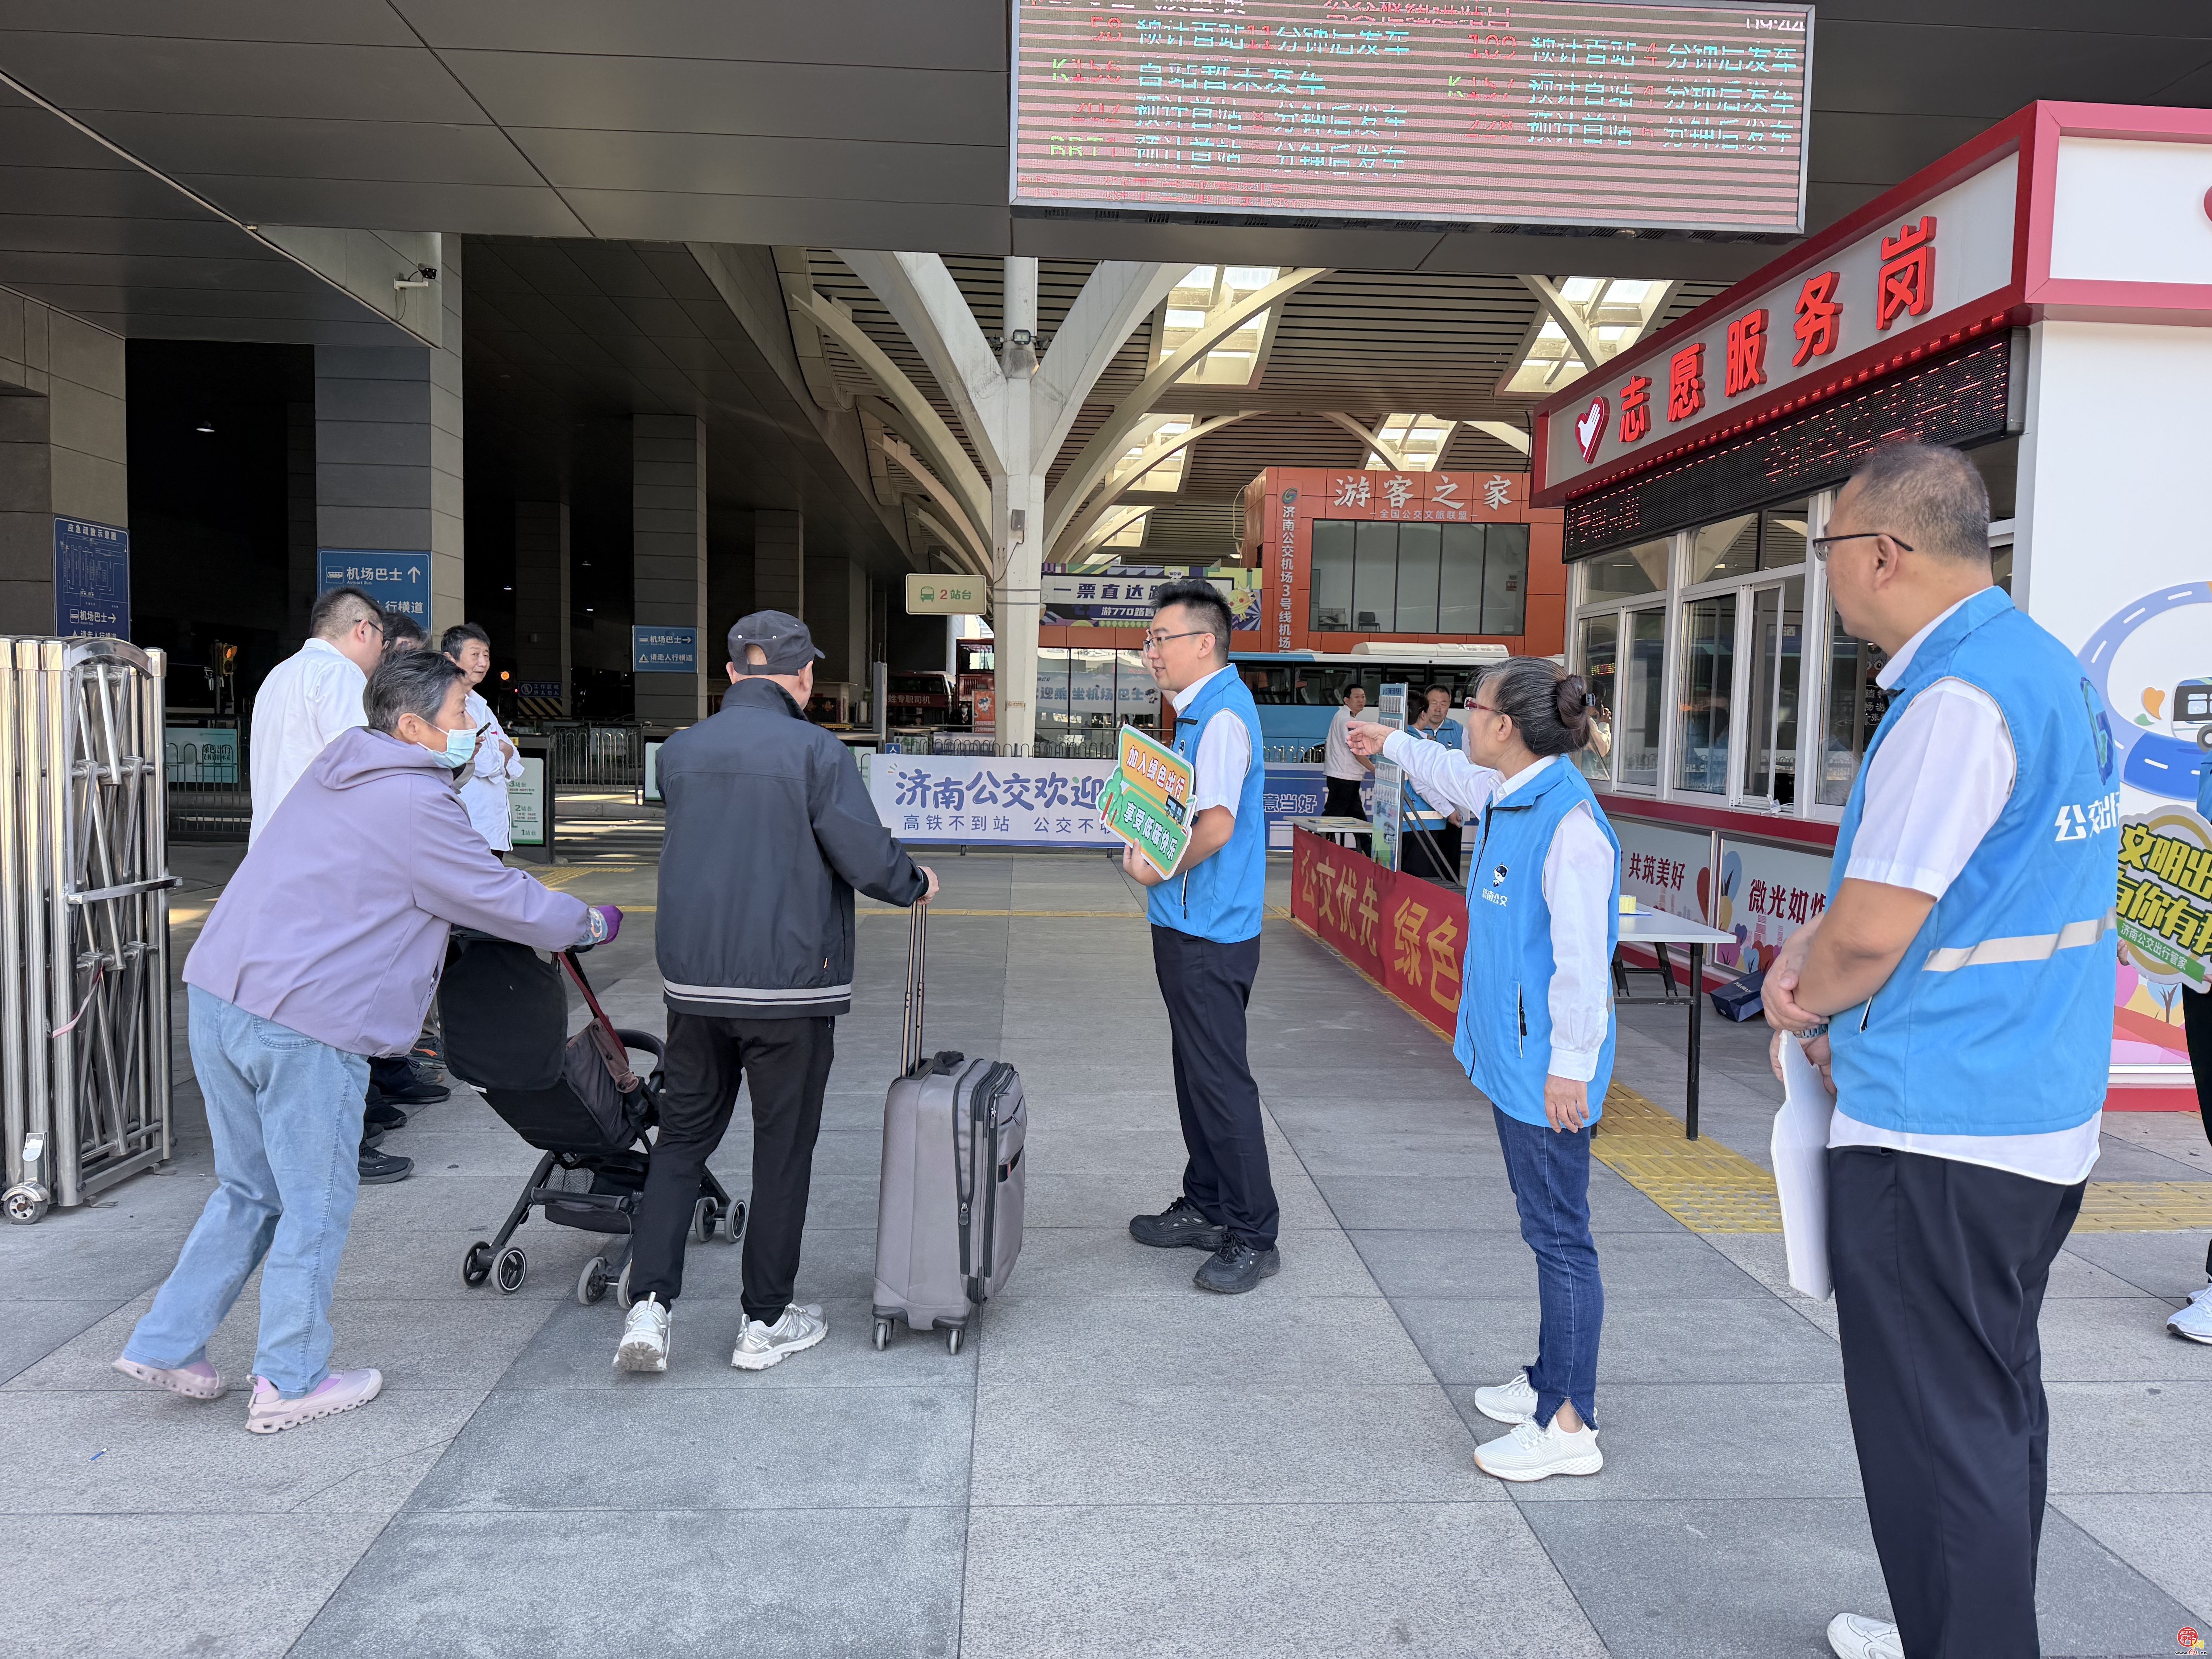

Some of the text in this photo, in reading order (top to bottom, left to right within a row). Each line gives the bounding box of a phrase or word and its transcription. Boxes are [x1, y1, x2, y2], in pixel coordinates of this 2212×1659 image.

[1619, 215, 1937, 443] 志愿服务岗
[1333, 475, 1513, 510] 游客之家
[1379, 508, 1468, 520] 全国公交文旅联盟
[347, 567, 403, 581] 机场巴士
[1278, 506, 1296, 653] 济南公交机场3号线机场
[80, 610, 108, 623] 机场巴士
[385, 600, 423, 614] 行横道
[650, 635, 682, 644] 机场巴士
[1036, 686, 1144, 701] 迎乘坐机场巴士
[895, 768, 1105, 811] 济南公交欢迎
[1127, 745, 1186, 800] 加入绿色出行
[903, 814, 1010, 832] 高铁不到站
[1123, 801, 1178, 862] 享受低碳快乐
[1628, 852, 1685, 891] 共筑美好
[1301, 850, 1460, 1013] 公交优先 绿色
[2121, 922, 2187, 970] 济南公交出行管家
